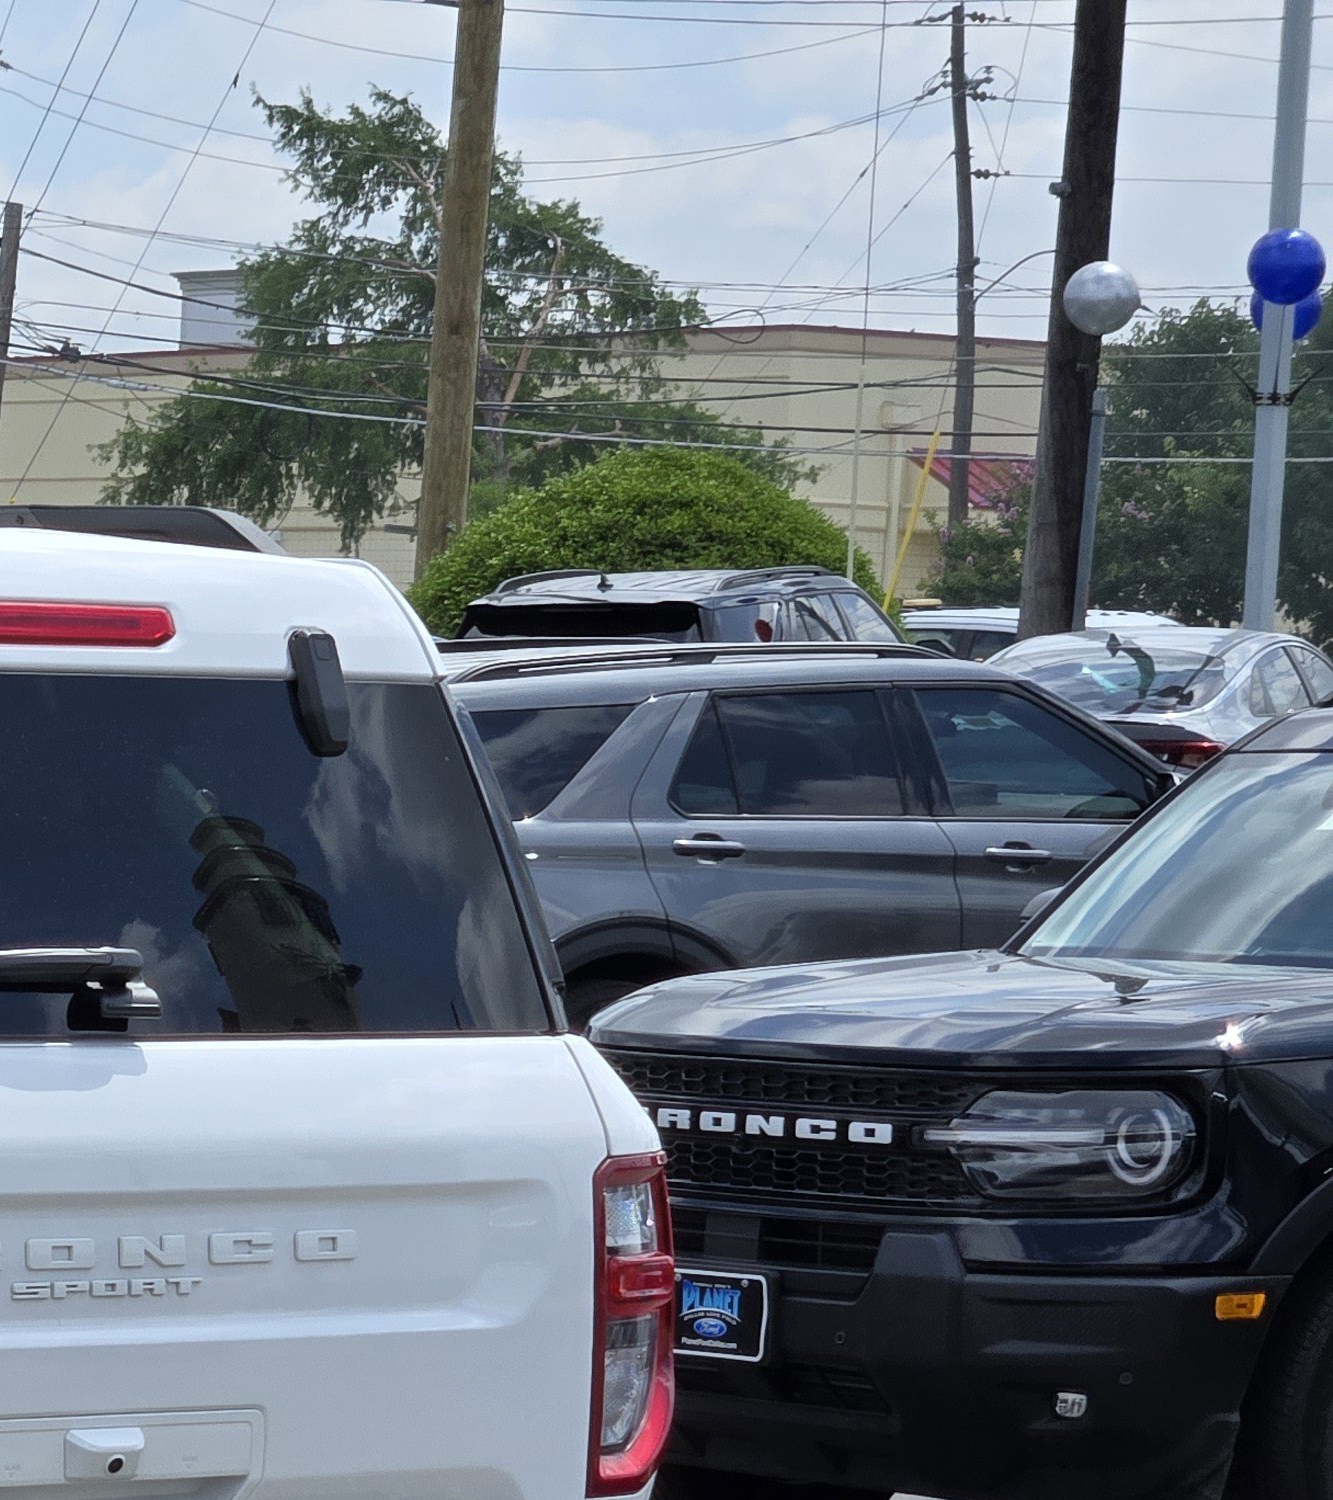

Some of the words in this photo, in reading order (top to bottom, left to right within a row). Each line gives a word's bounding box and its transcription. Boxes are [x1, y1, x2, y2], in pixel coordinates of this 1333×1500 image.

[642, 1107, 893, 1144] RONCO
[11, 1277, 203, 1300] SPORT
[682, 1280, 741, 1319] PLANET
